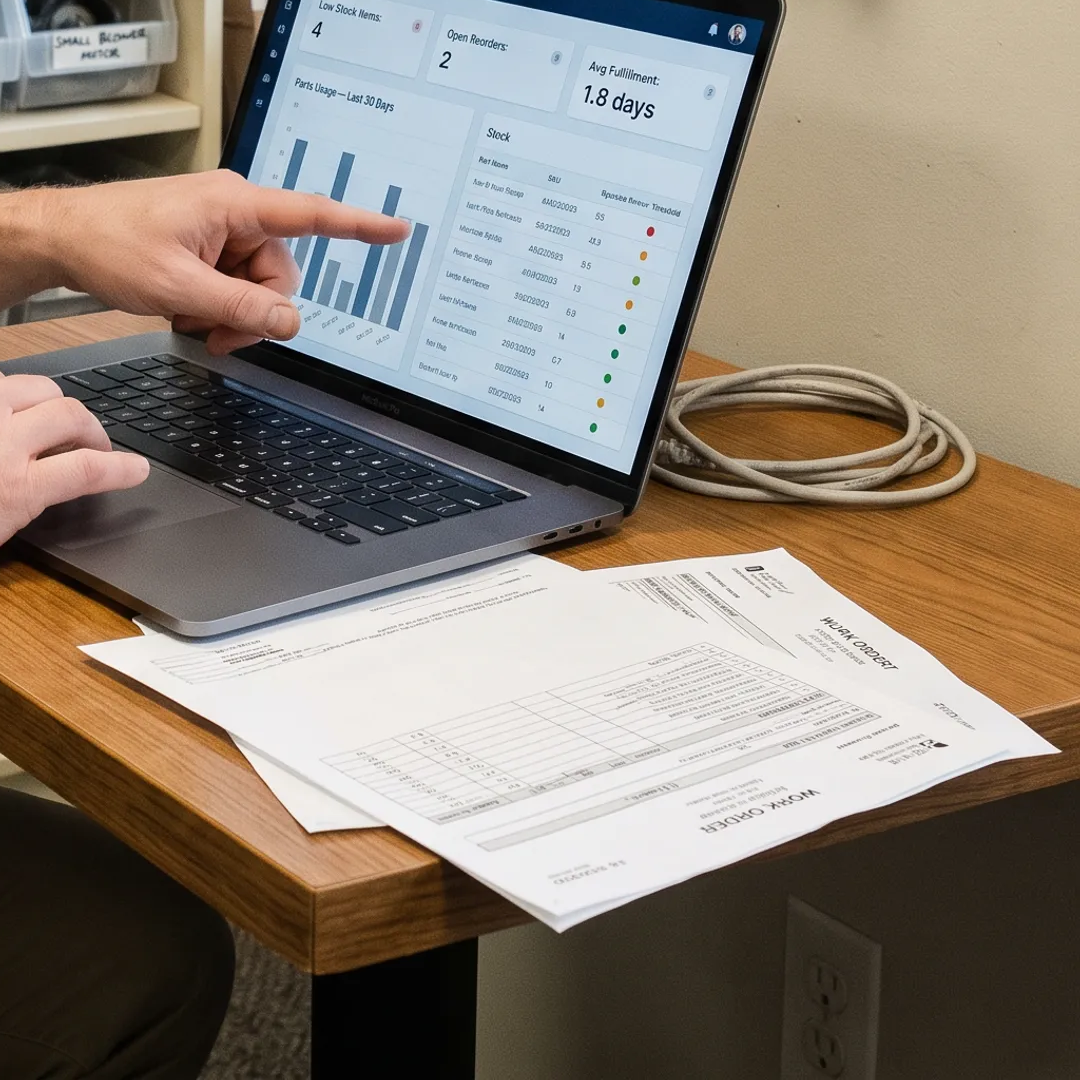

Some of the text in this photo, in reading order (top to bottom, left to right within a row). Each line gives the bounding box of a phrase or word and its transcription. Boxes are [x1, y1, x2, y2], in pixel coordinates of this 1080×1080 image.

[319, 0, 334, 12] Low
[311, 21, 324, 38] 4
[54, 35, 93, 49] SMALL
[447, 28, 509, 52] Open Reorders:
[439, 51, 452, 69] 2
[588, 60, 607, 76] Avg
[295, 77, 314, 91] Parts
[314, 82, 337, 99] Usage
[346, 91, 364, 104] Last
[364, 94, 375, 107] 30
[583, 84, 657, 121] 1.8 days
[486, 127, 511, 143] Stock
[699, 788, 821, 835] WORK ORDER
